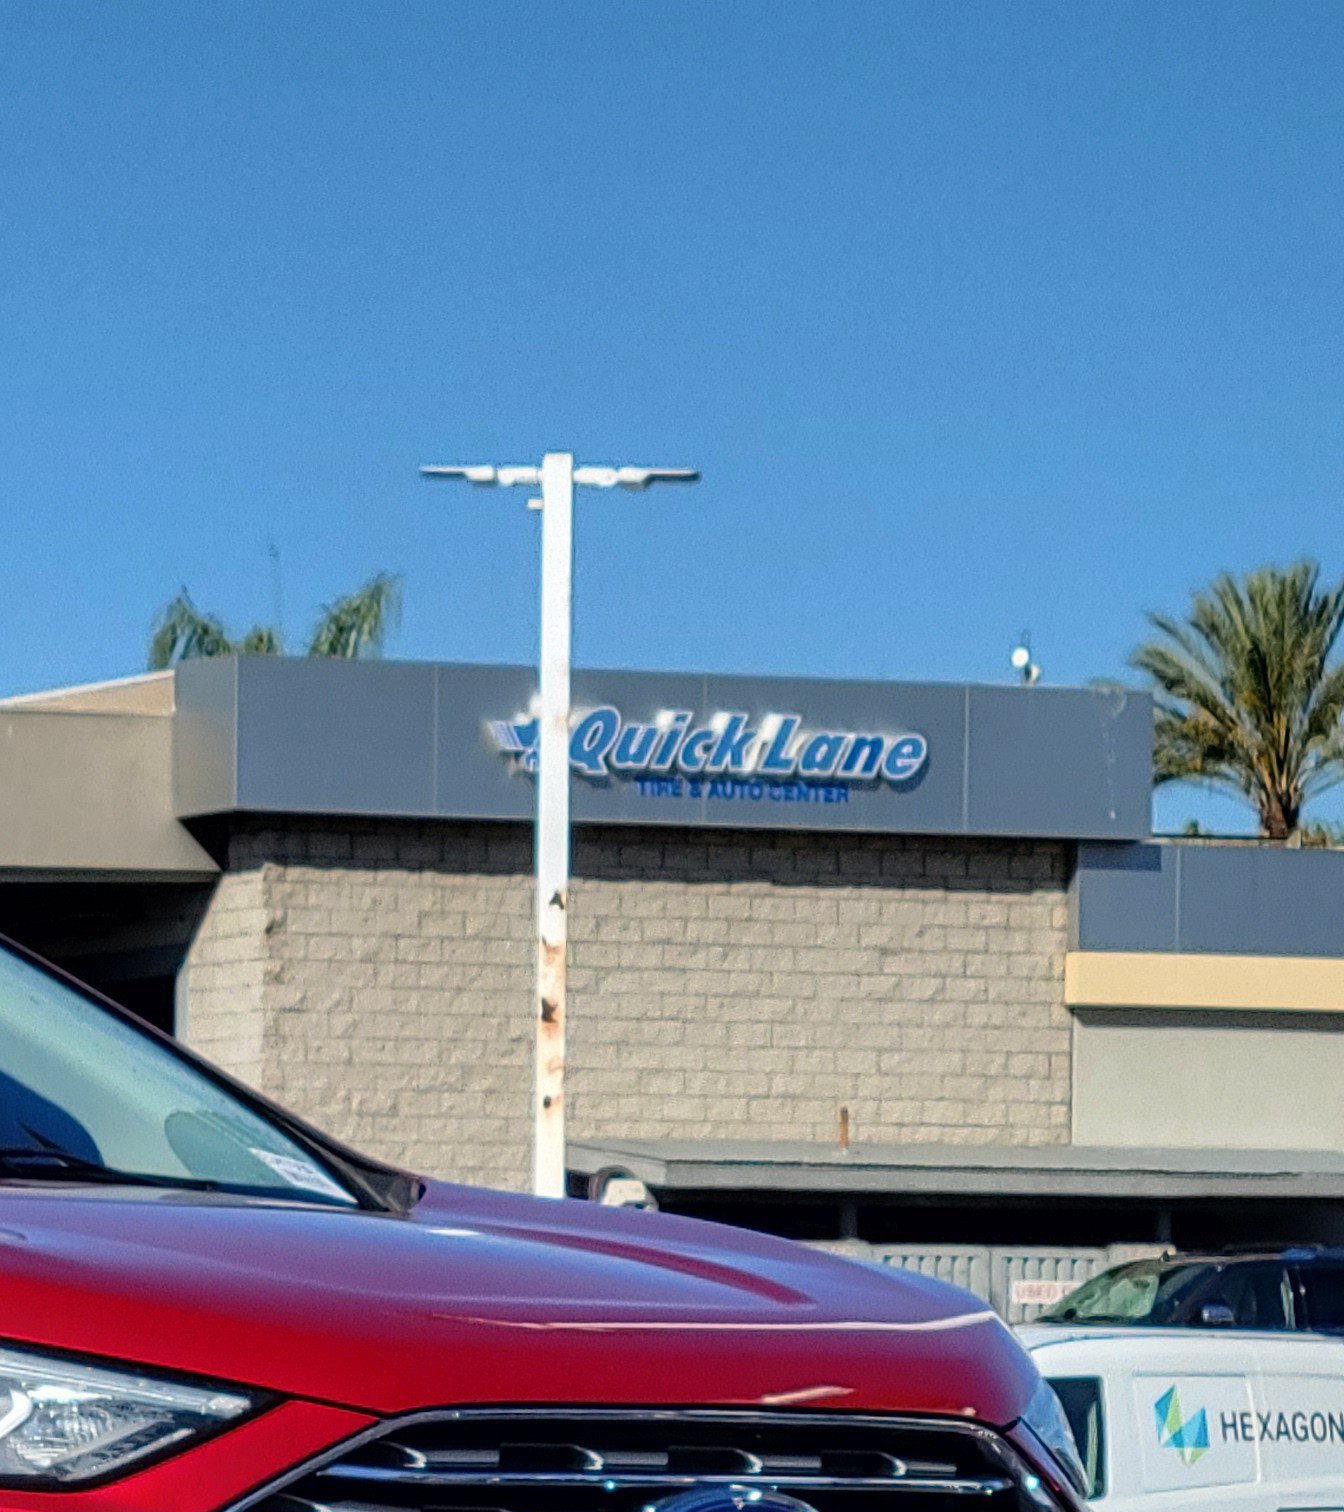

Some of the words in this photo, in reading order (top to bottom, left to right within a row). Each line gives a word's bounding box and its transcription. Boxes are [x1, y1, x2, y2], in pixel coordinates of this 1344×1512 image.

[569, 706, 757, 775] Quick
[759, 712, 927, 780] Lane
[635, 777, 683, 797] TIRE
[707, 780, 763, 801] AUTO
[765, 782, 850, 803] CENTER
[1220, 1410, 1344, 1442] HEXAGON
